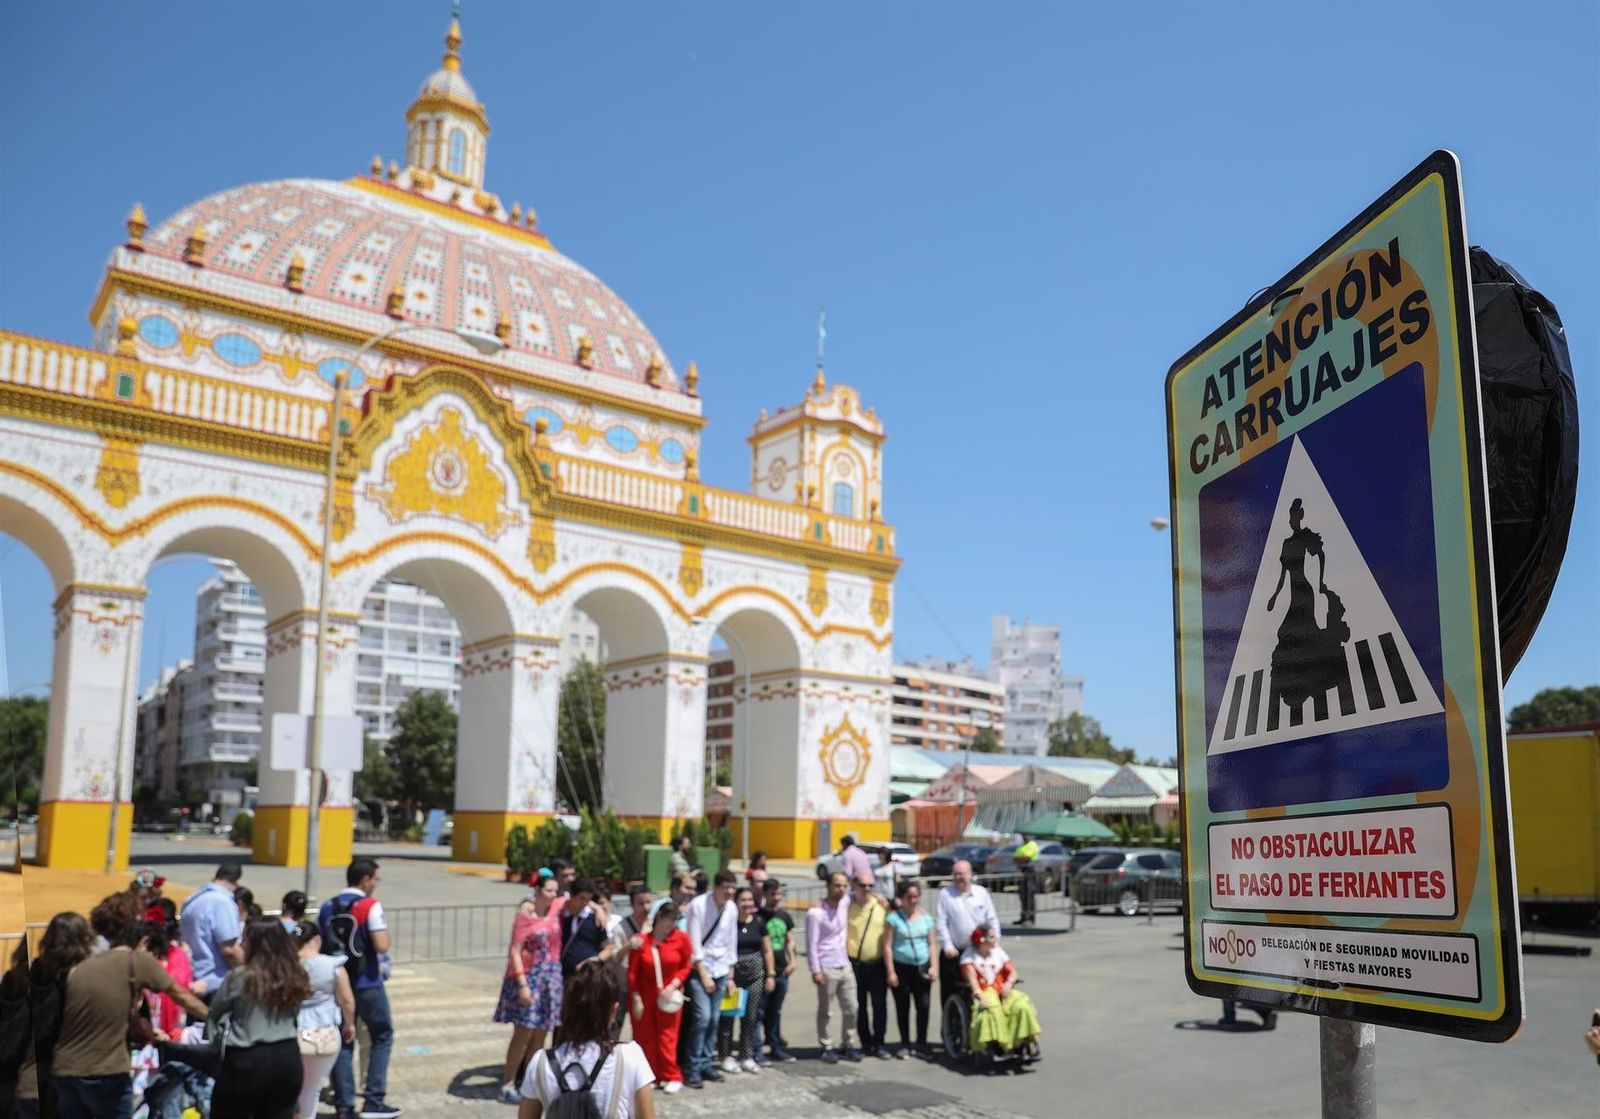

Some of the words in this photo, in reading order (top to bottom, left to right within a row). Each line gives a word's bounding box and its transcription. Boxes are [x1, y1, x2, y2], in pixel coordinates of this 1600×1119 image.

[1201, 236, 1402, 420] ATENCIÓN
[1189, 289, 1430, 475] CARRUAJES
[1231, 835, 1254, 860] NO
[1259, 826, 1417, 859] OBSTACULIZAR
[1215, 873, 1236, 896] EL
[1239, 873, 1283, 897] PASO
[1289, 872, 1313, 897] DE
[1319, 870, 1446, 899] FERIANTES
[1261, 937, 1317, 952] DELEGACIÓN
[1319, 942, 1333, 953] DE
[1335, 943, 1398, 958] SEGURIDAD
[1401, 948, 1470, 964] MOVILIDAD
[1304, 958, 1310, 969] Y
[1313, 959, 1355, 973] FIESTAS
[1358, 963, 1412, 979] MAYORES
